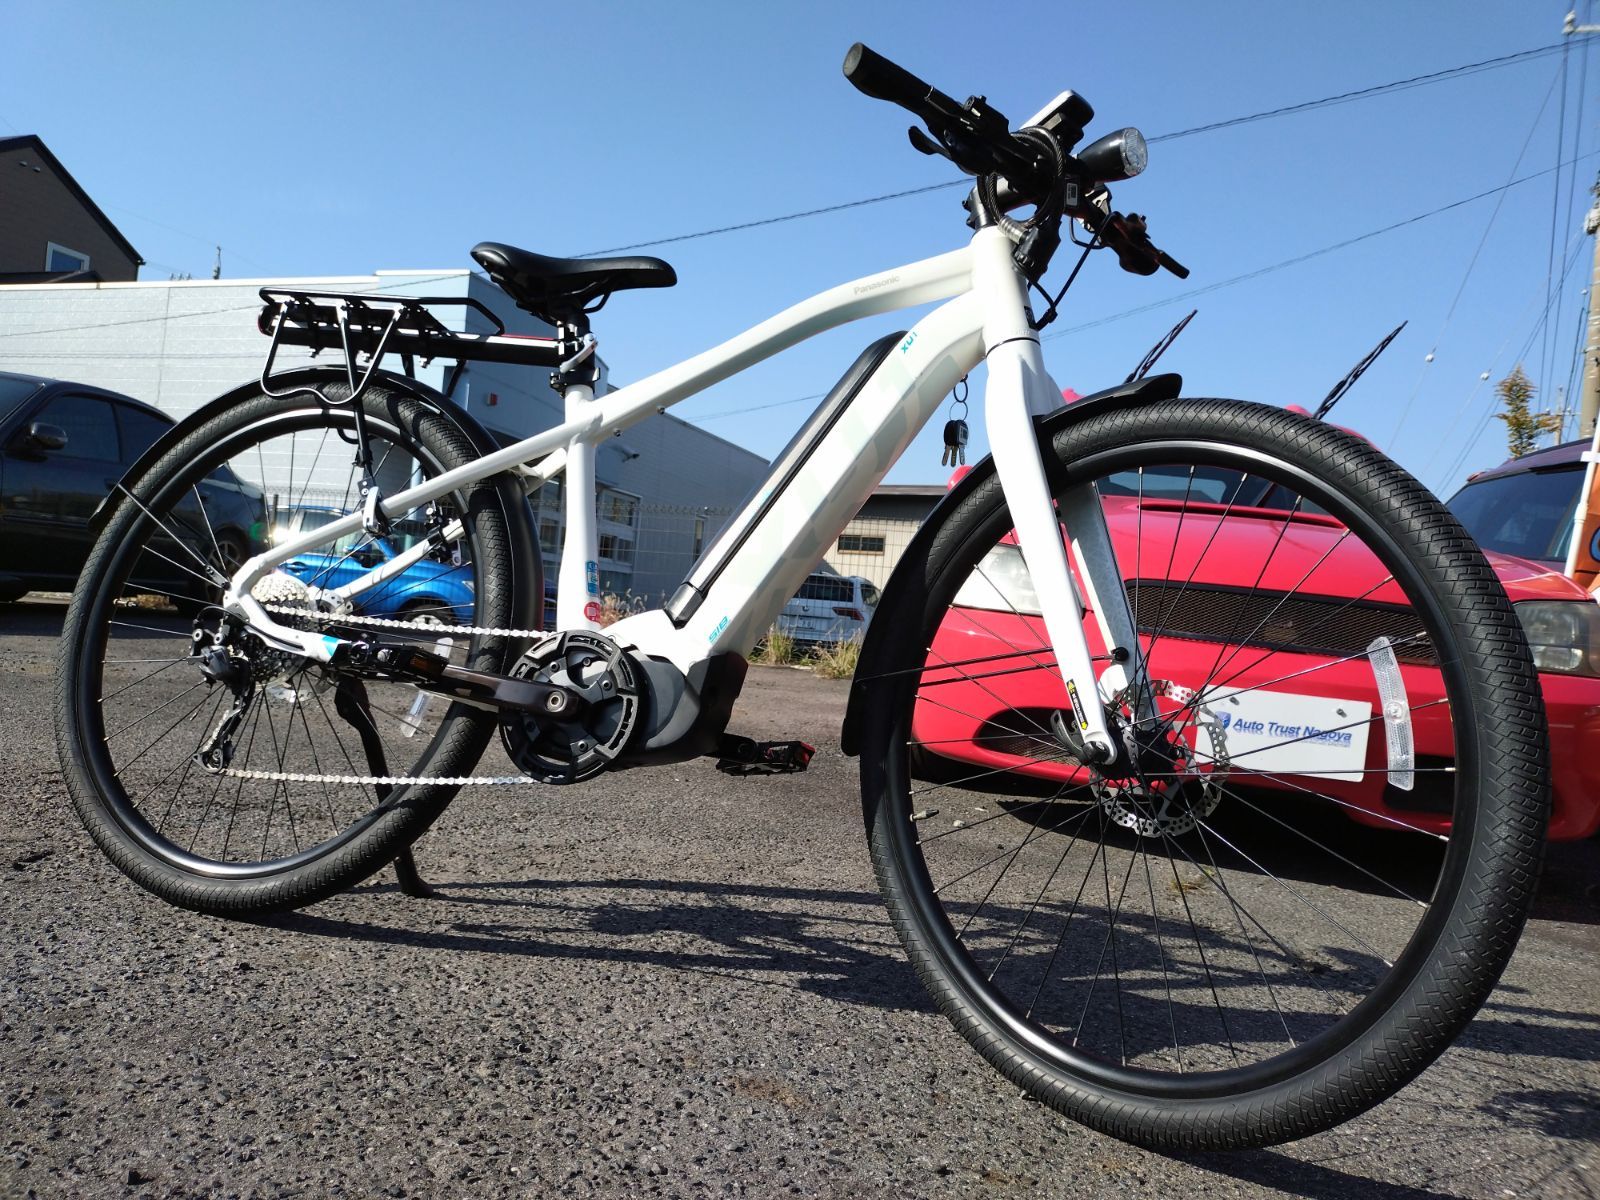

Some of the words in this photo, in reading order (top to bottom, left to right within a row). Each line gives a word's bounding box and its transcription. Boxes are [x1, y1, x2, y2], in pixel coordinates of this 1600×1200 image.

[853, 275, 900, 295] Panasonic
[1233, 718, 1264, 731] Auto
[1268, 721, 1301, 738] Trust
[1303, 726, 1352, 742] Nagoya
